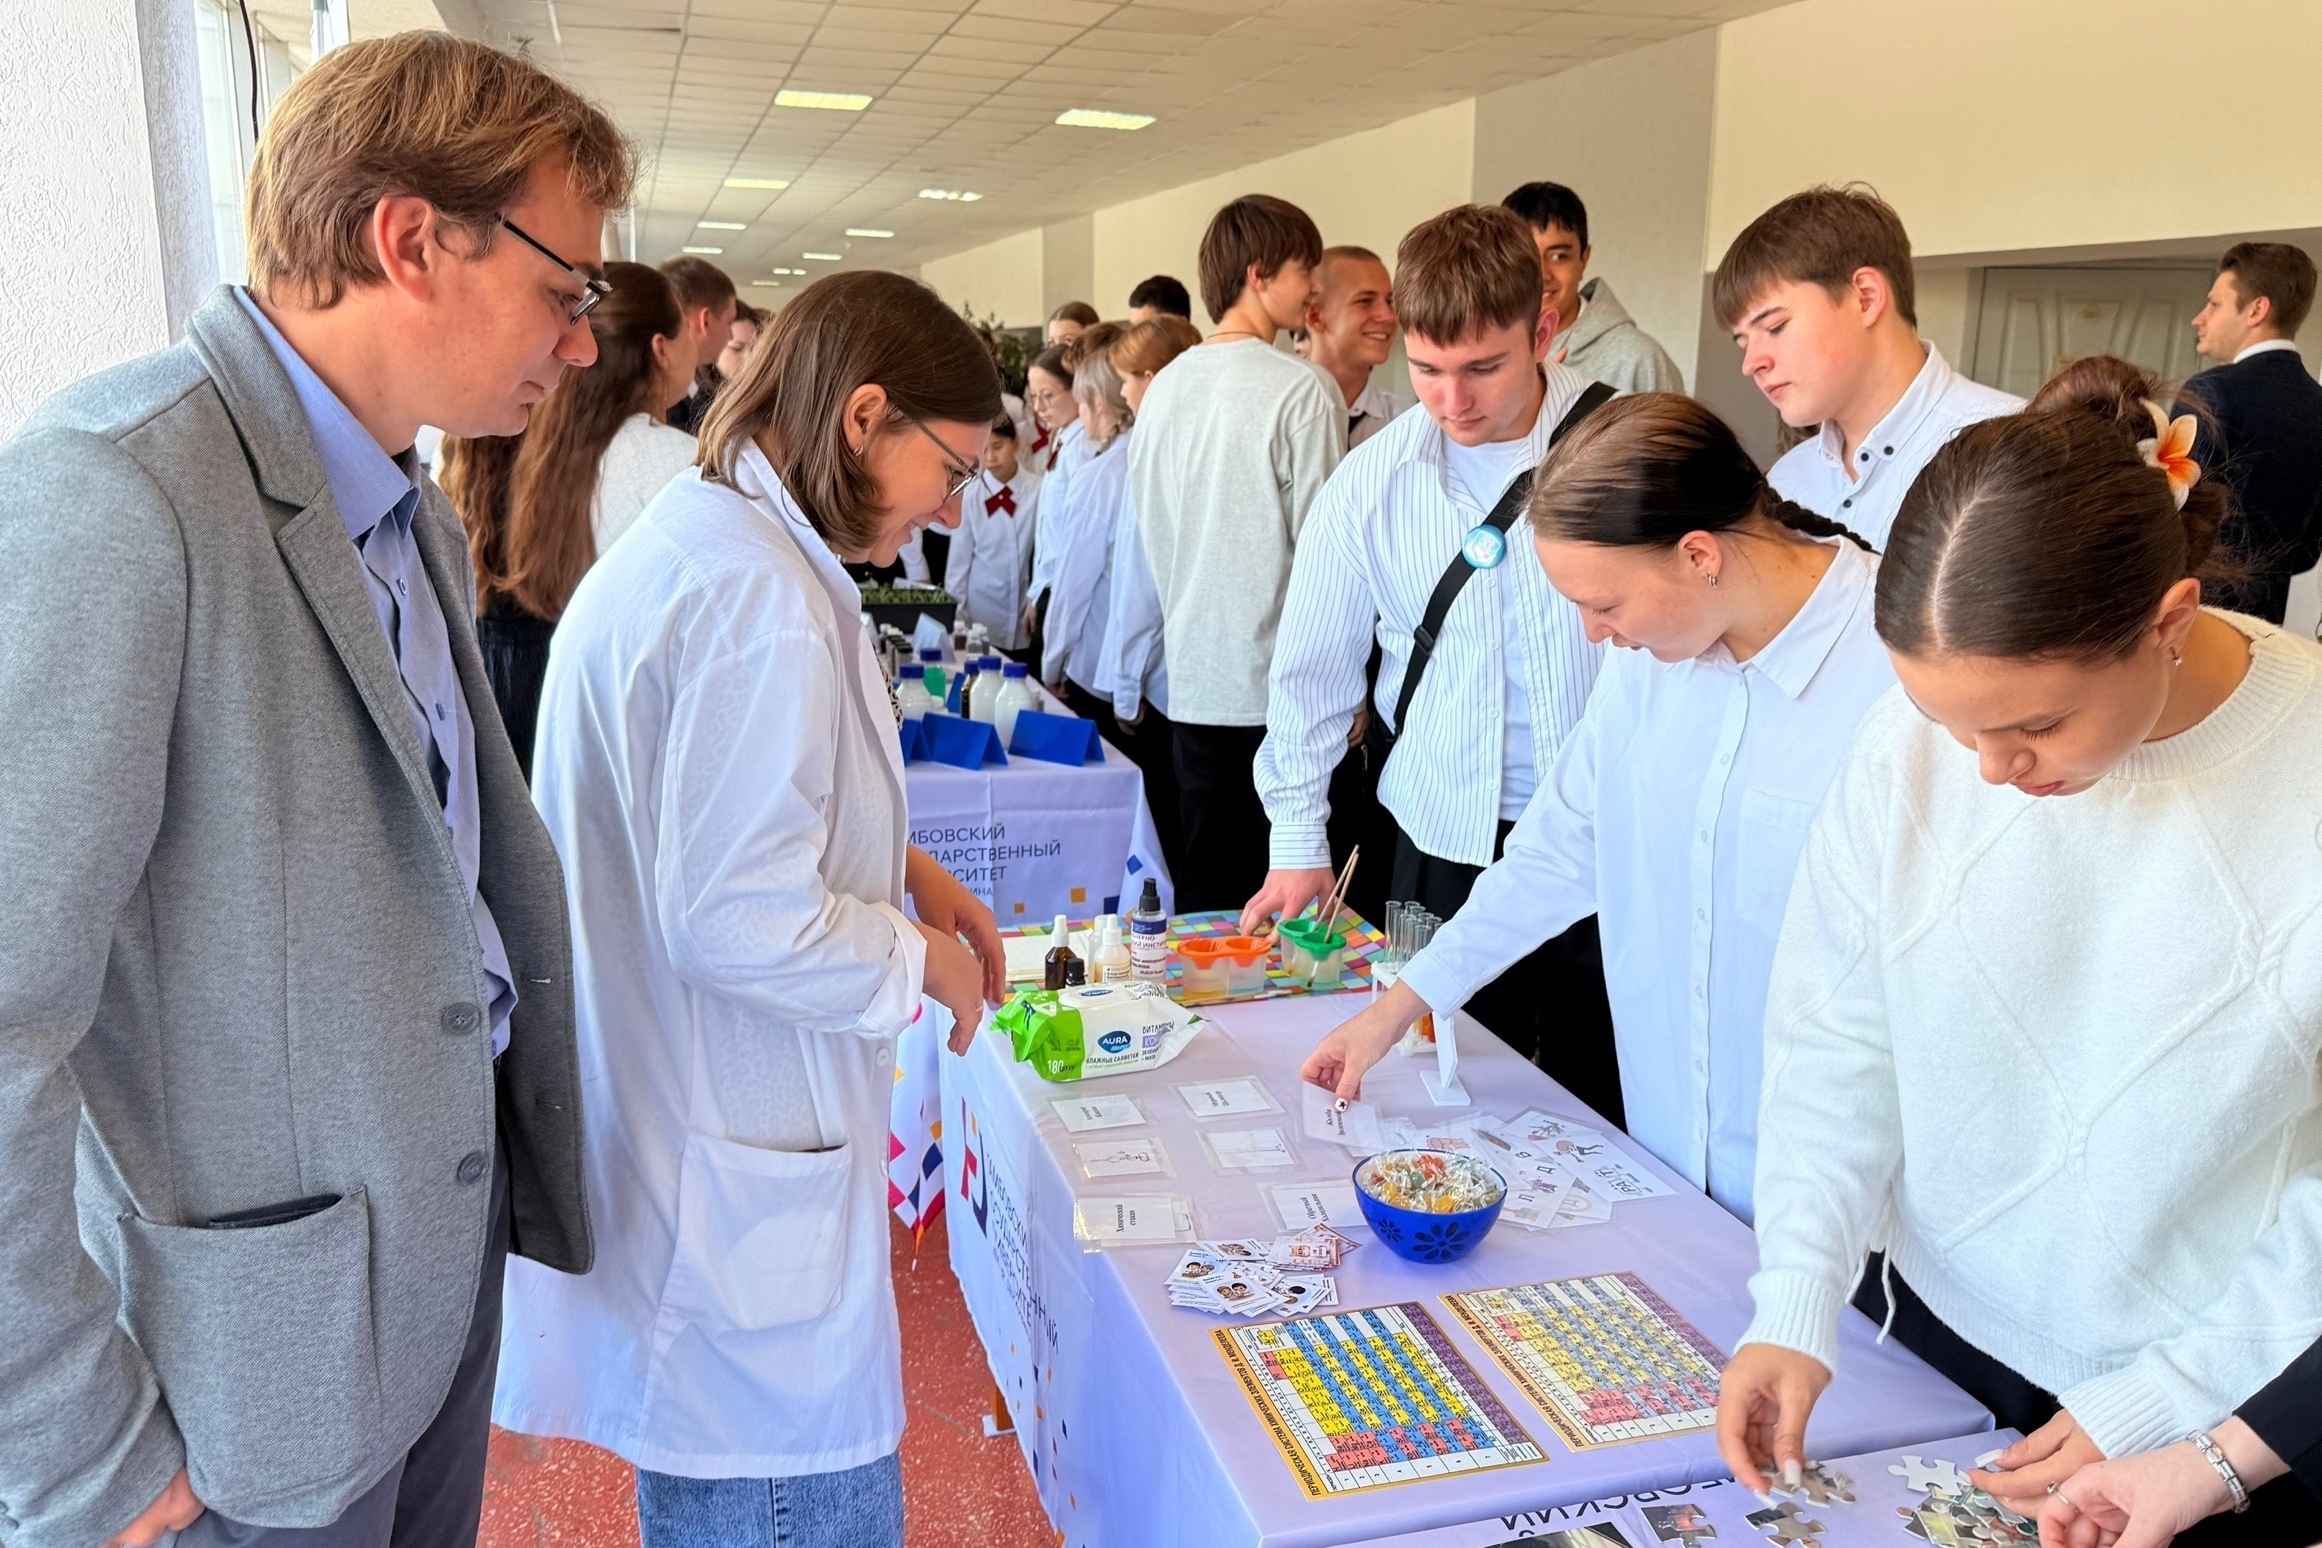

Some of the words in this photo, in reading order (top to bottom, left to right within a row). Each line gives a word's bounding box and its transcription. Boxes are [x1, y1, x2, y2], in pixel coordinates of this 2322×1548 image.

[908, 823, 1006, 845] МБОВСКИЙ
[928, 839, 1061, 864] ДАРСТВЕННЫЙ
[955, 866, 1008, 883] СИТЕТ
[969, 887, 993, 897] ИНА
[1102, 1035, 1128, 1045] AURA
[1086, 1055, 1113, 1065] ВЛАЖНЫЕ
[1113, 1052, 1139, 1063] САЛФЕТКИ
[1271, 1425, 1294, 1449] СИСТЕМА
[1285, 1448, 1323, 1496] ПЕРИОДИЧЕСКАЯ
